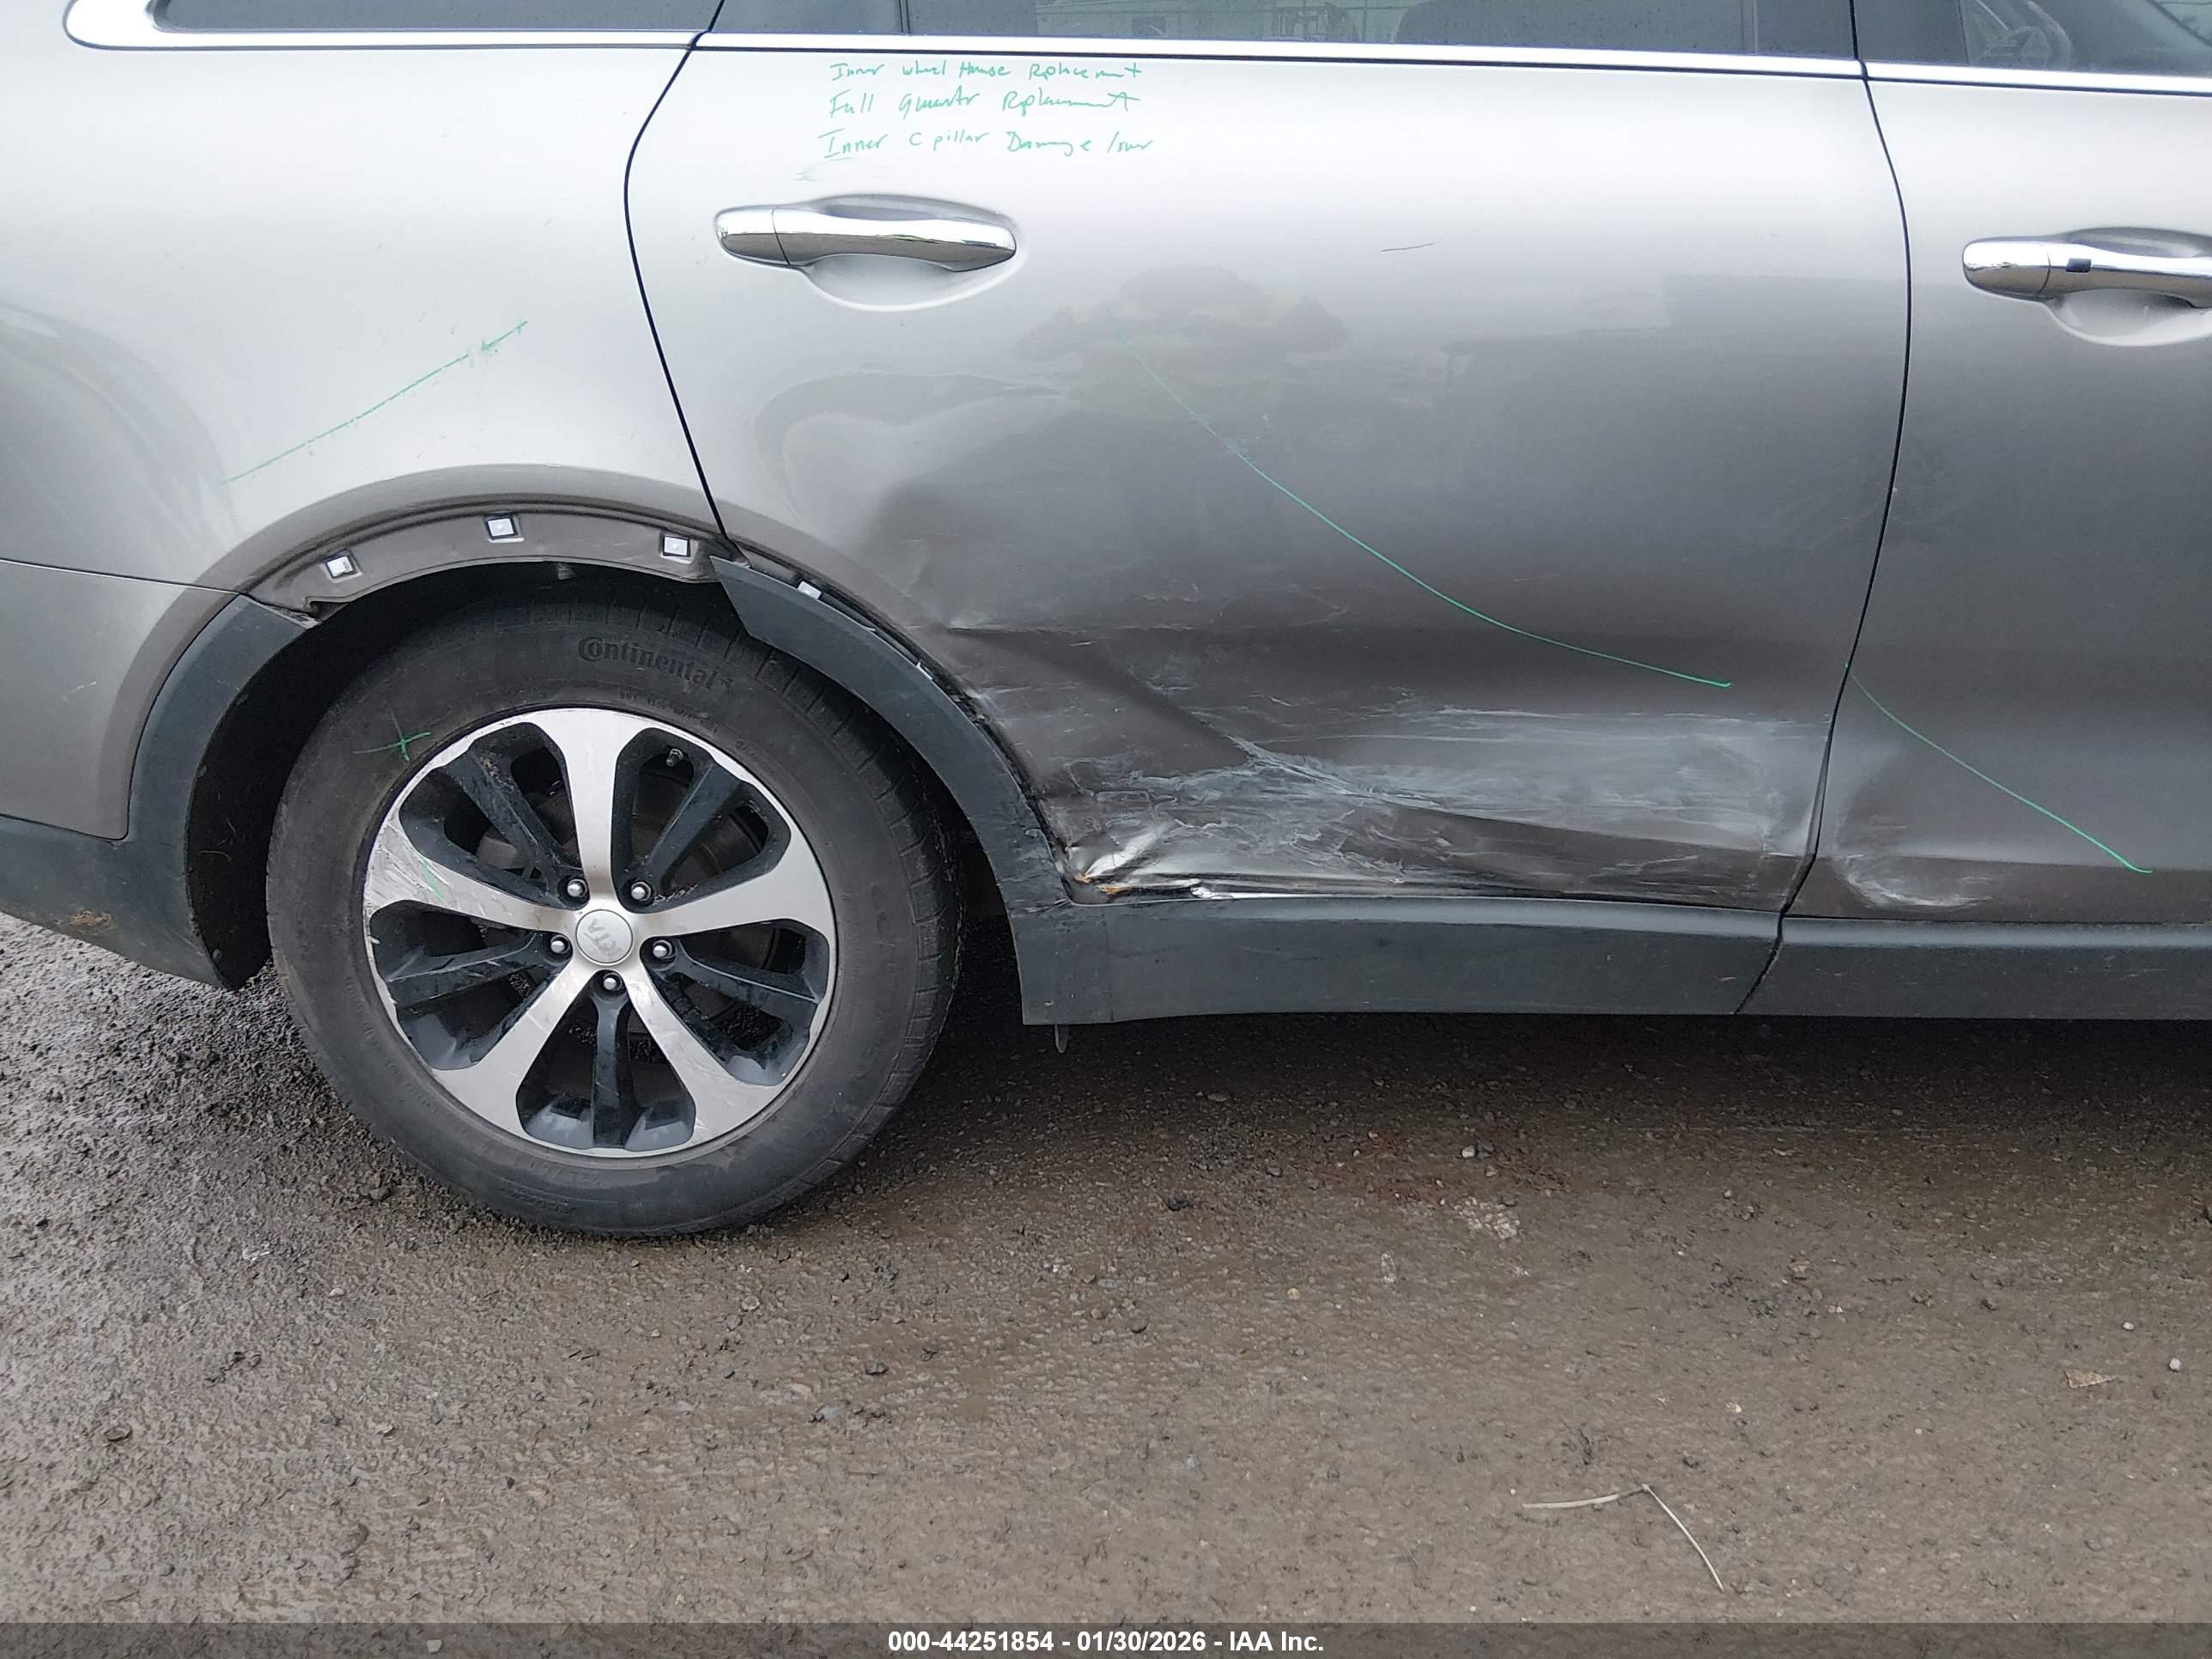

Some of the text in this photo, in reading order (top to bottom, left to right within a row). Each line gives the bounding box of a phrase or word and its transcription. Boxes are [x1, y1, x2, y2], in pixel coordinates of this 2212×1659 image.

[830, 63, 885, 81] Inner
[829, 88, 874, 118] Full
[817, 128, 889, 158] Inner
[908, 131, 922, 146] C
[577, 636, 718, 690] Continental
